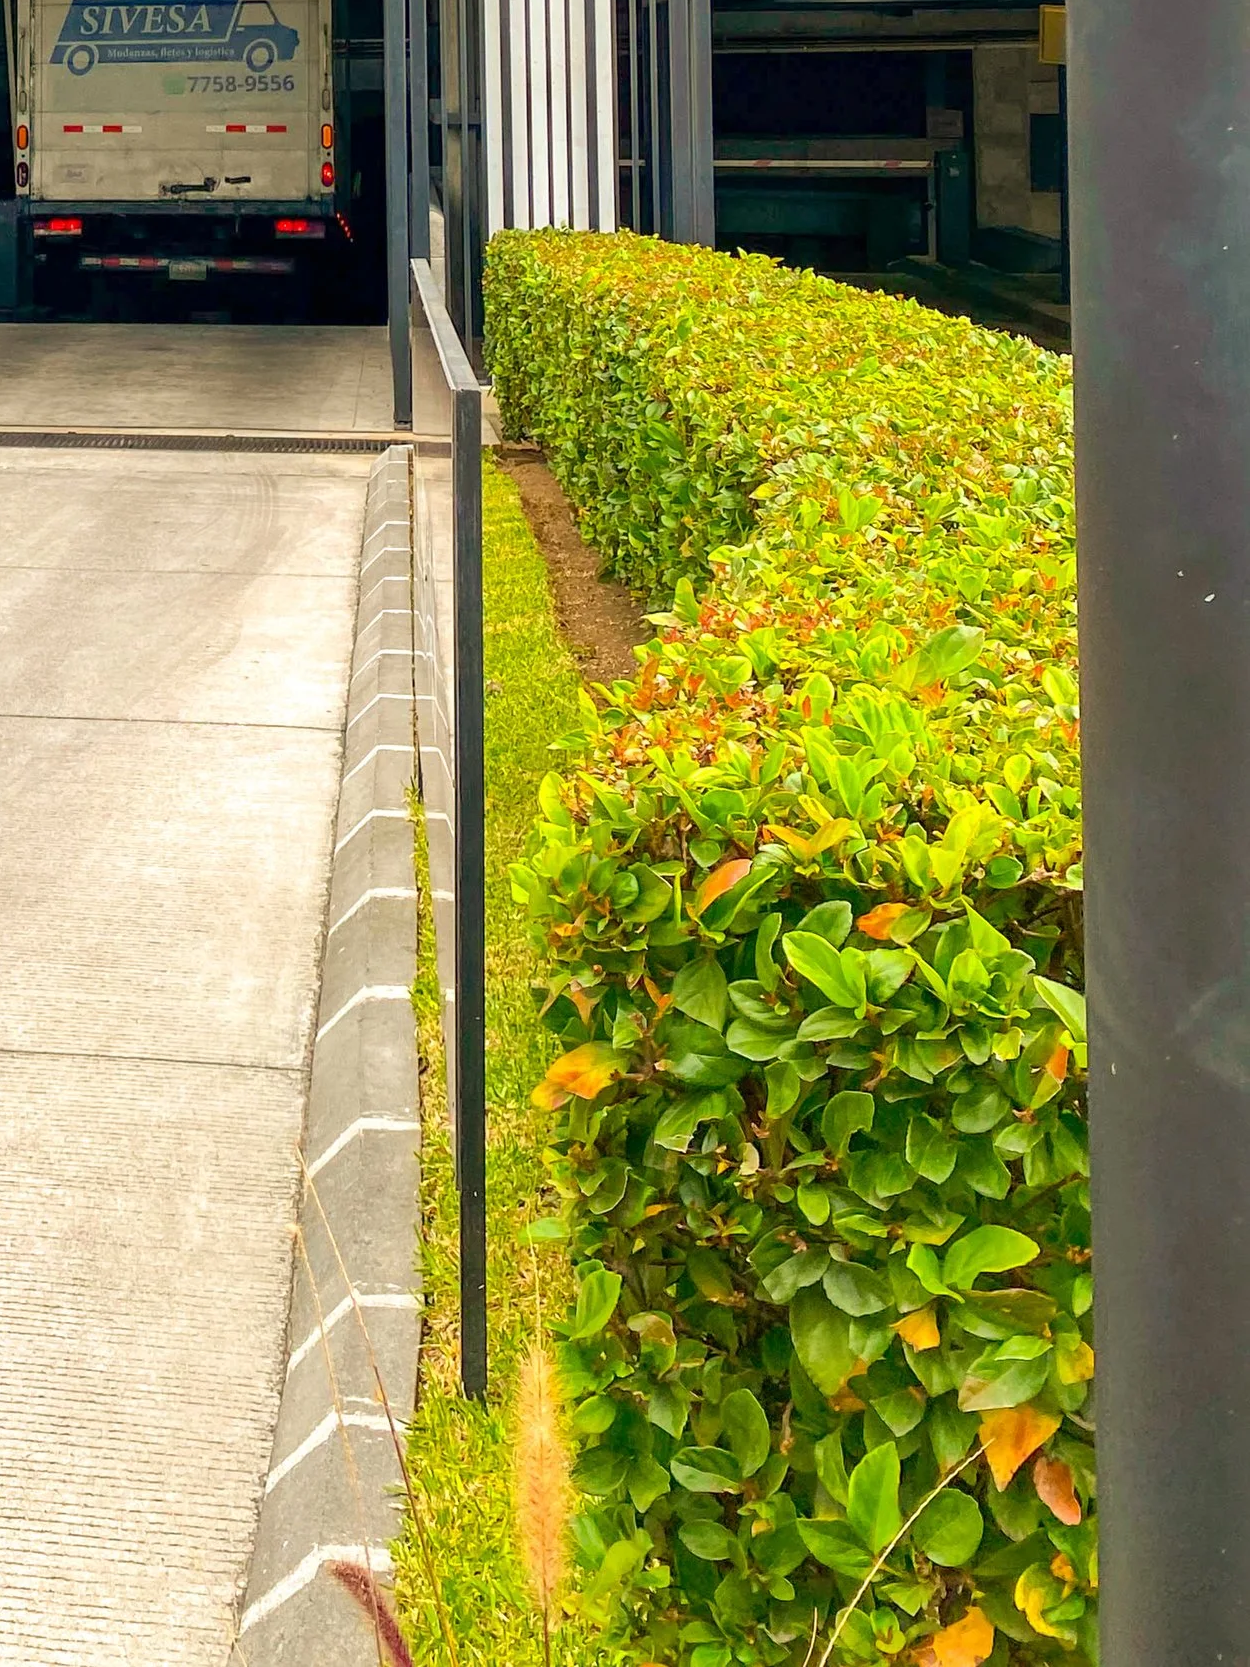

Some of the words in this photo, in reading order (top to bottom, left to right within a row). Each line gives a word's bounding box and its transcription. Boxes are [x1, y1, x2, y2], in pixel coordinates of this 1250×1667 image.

[80, 4, 211, 34] SIVESA
[107, 47, 158, 59] Mudanzas,
[187, 75, 295, 93] 7758-9556
